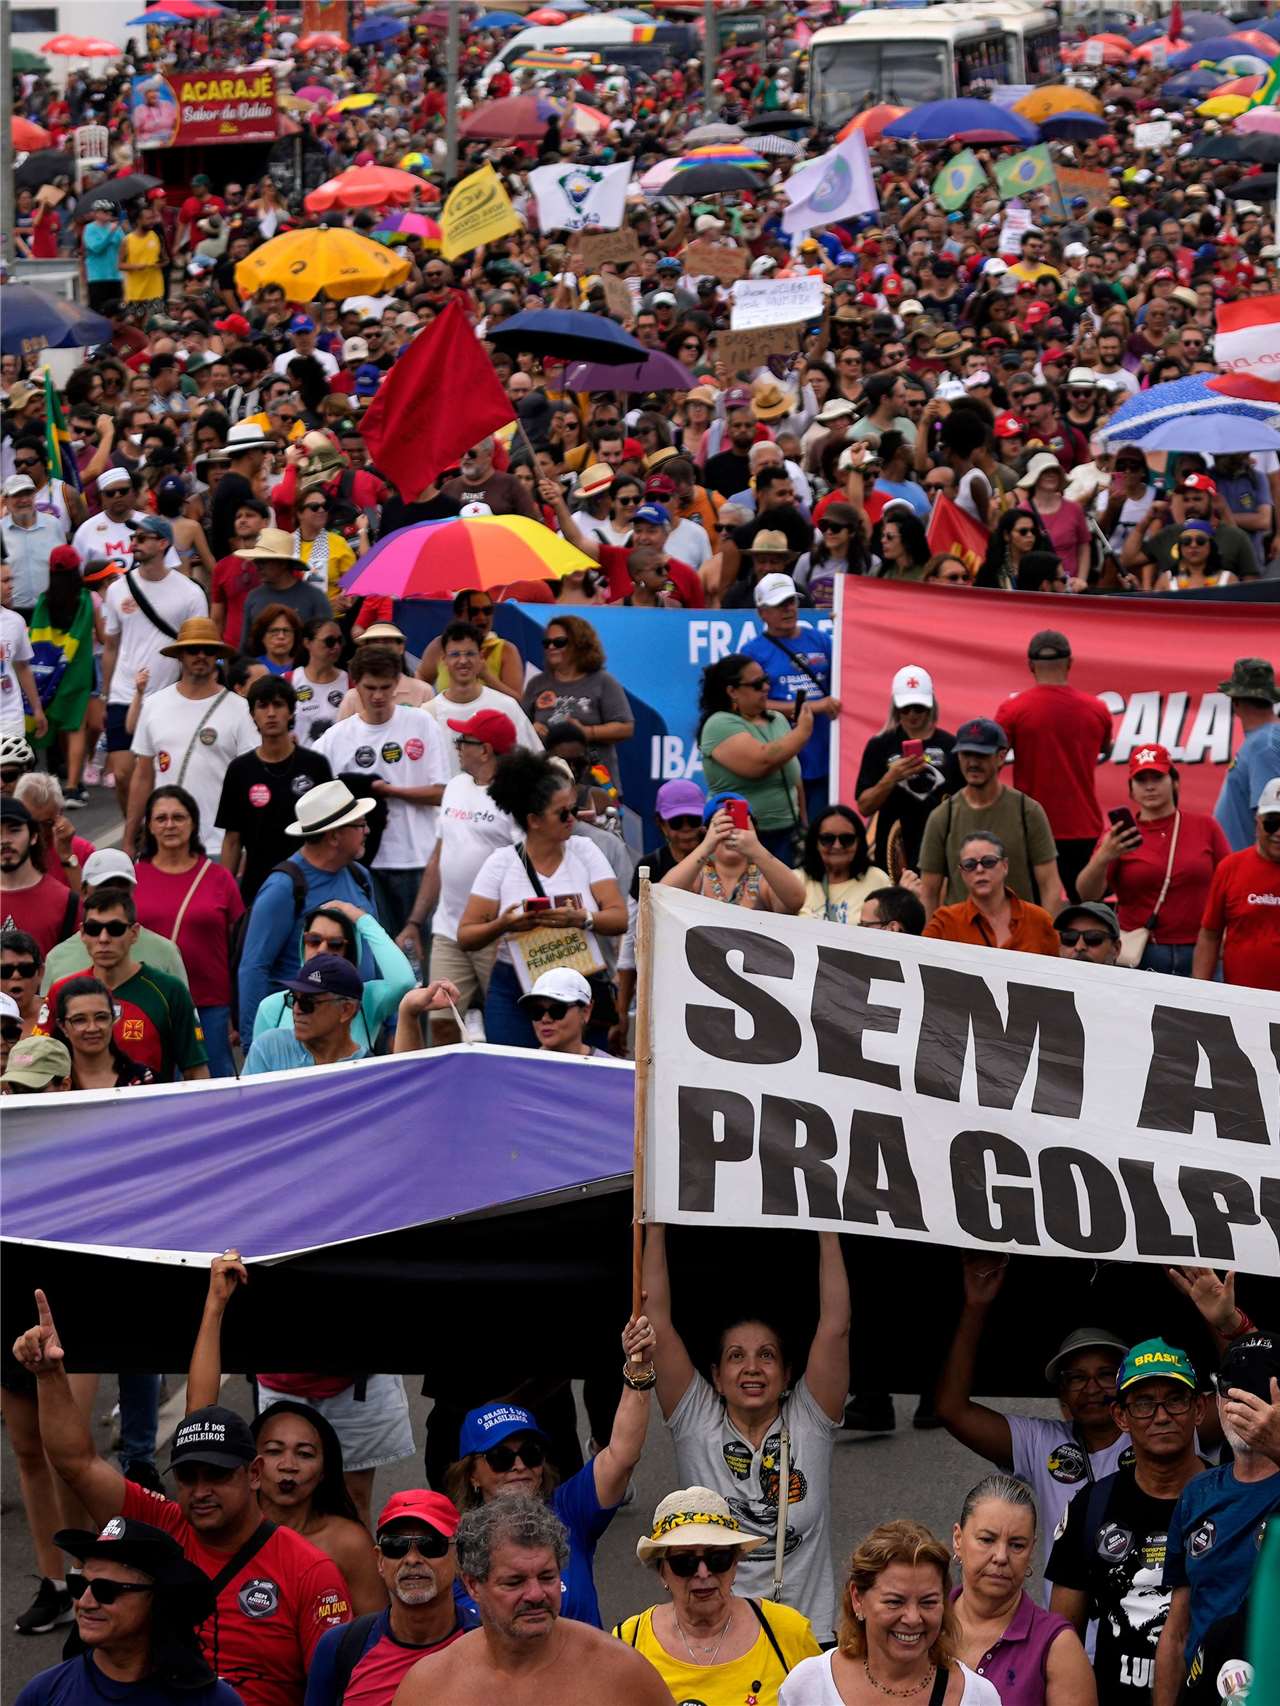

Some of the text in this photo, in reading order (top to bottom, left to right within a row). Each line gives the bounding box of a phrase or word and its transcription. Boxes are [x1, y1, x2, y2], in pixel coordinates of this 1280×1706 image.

[181, 73, 273, 102] ACARAJÉ
[184, 106, 219, 122] Sabor
[564, 933, 580, 945] DE
[684, 925, 1085, 1119] SEM
[677, 1085, 929, 1232] PRA
[1135, 1352, 1182, 1367] BRASIL
[482, 1408, 509, 1422] BRASIL
[211, 1423, 226, 1432] DOS
[176, 1432, 225, 1447] BRASILEIROS
[254, 1592, 268, 1600] SEM
